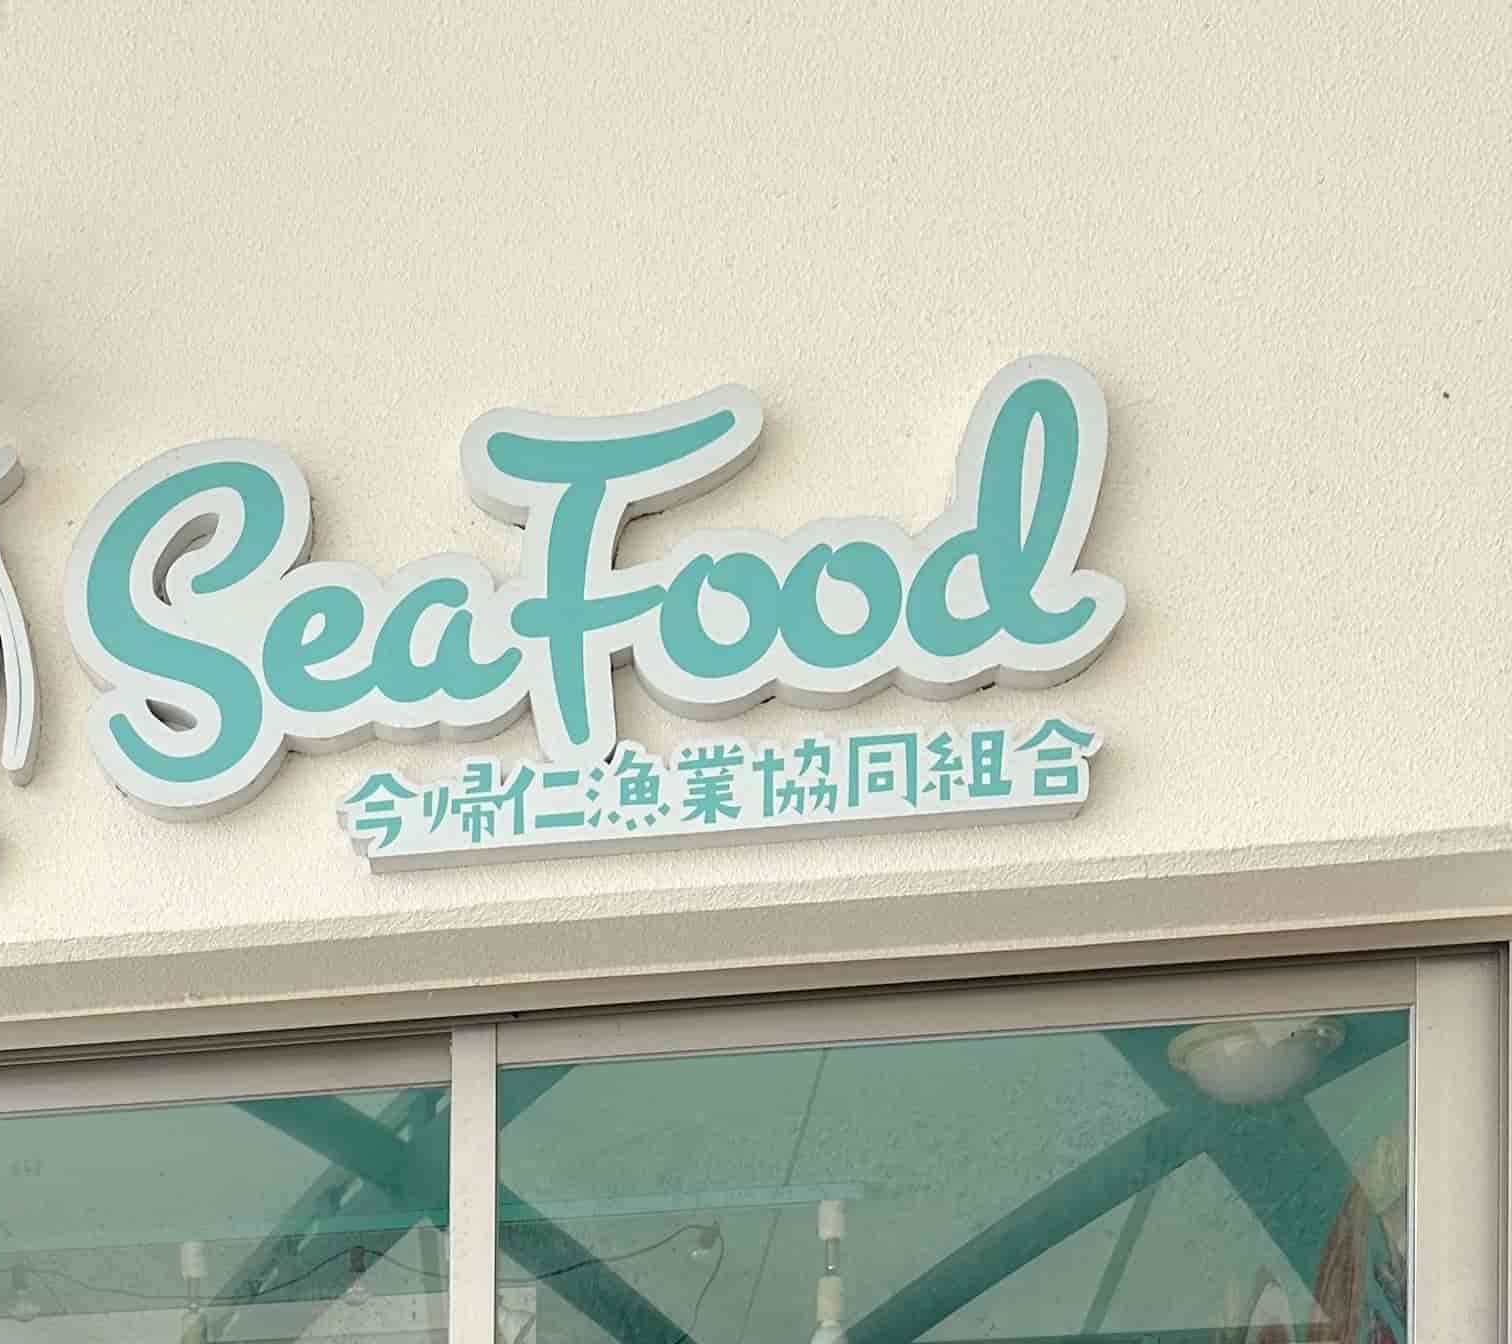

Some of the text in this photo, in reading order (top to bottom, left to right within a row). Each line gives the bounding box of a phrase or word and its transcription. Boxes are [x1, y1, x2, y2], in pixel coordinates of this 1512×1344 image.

[345, 718, 1096, 845] 今帰仁漁業協同組合
